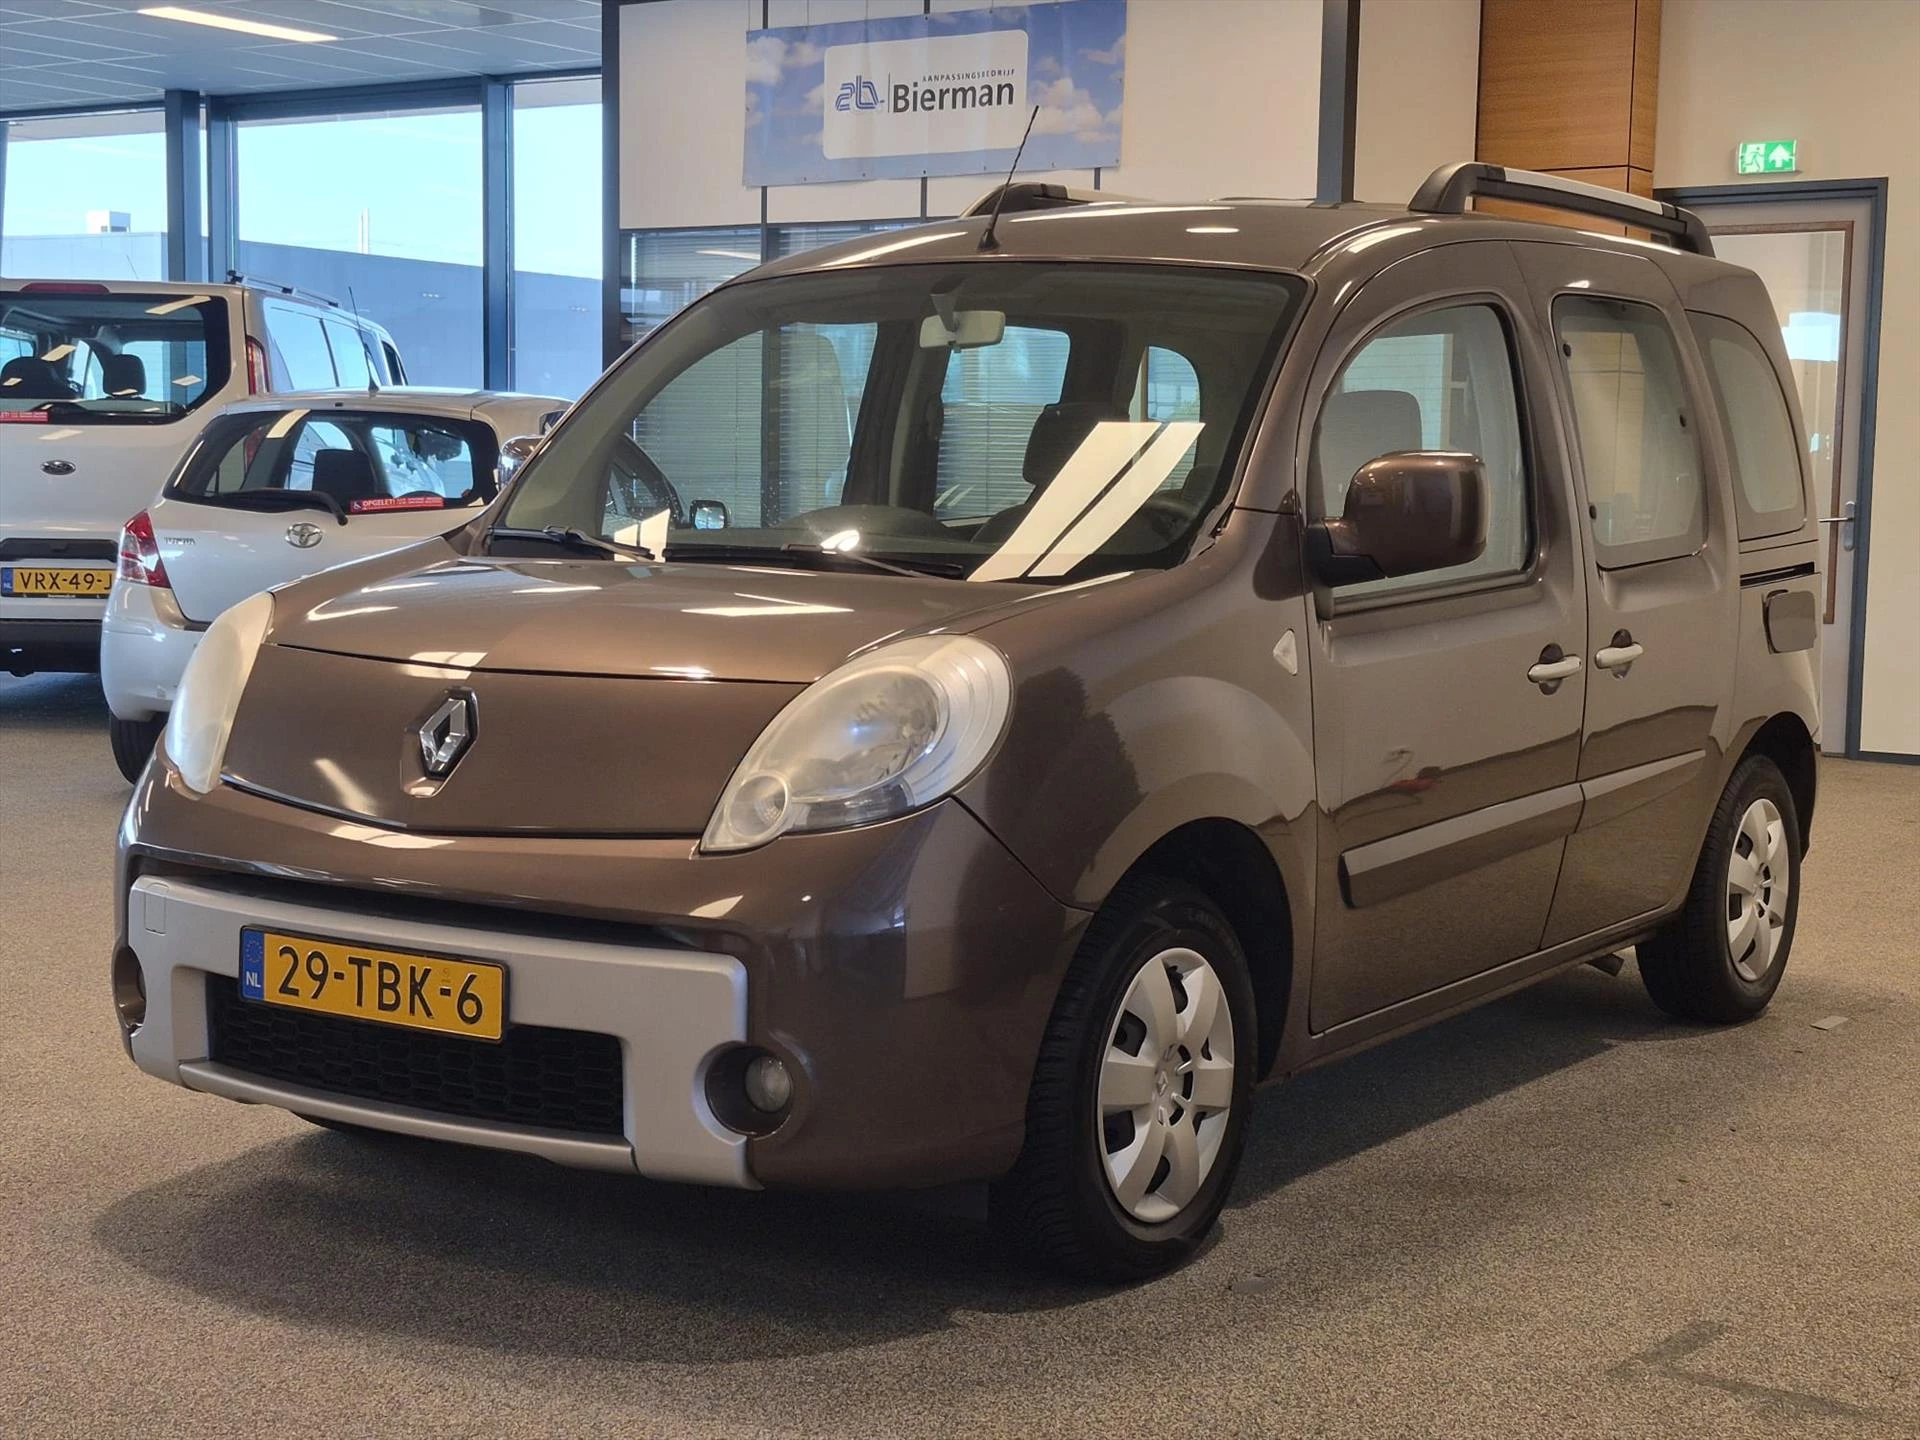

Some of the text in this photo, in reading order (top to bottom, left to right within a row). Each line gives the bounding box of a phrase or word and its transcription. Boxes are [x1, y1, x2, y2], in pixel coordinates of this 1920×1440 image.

[893, 81, 1014, 113] Bierman
[246, 971, 261, 988] NL
[278, 945, 484, 1025] 29-TBK-6
